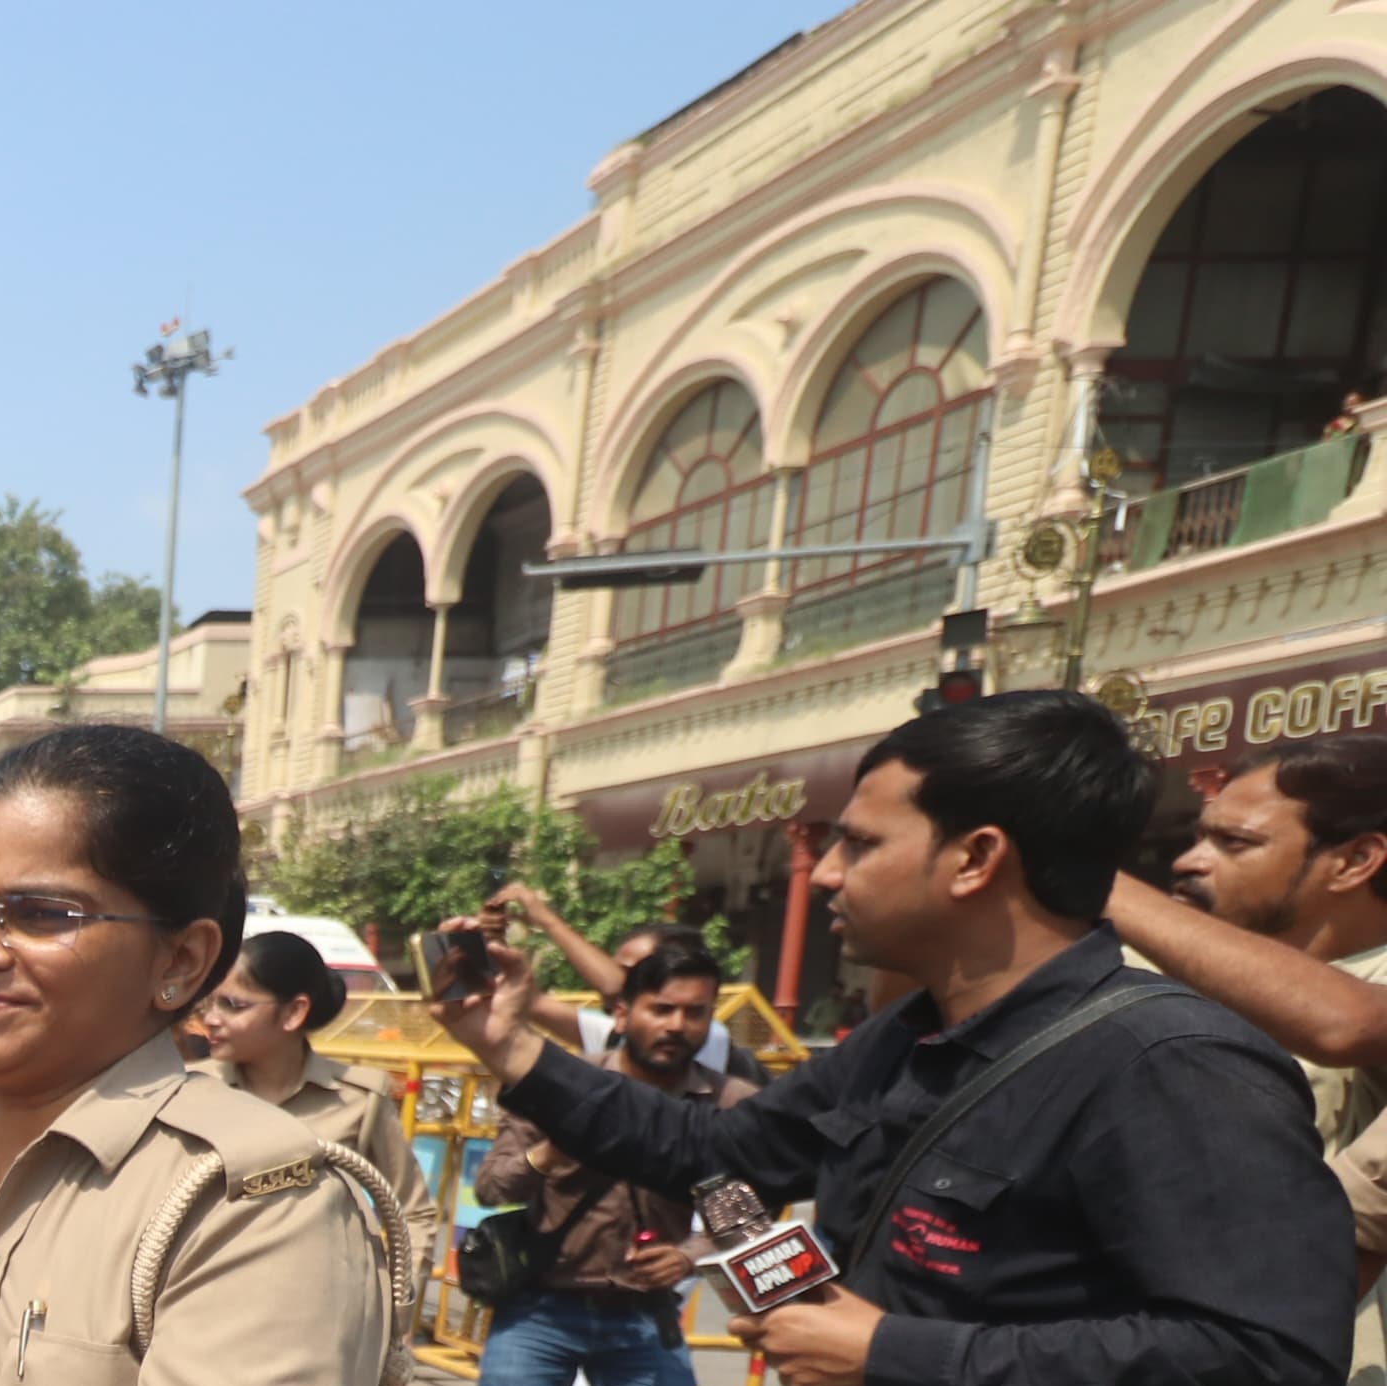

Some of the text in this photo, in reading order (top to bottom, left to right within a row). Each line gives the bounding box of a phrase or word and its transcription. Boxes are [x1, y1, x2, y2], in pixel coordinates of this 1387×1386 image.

[1245, 667, 1387, 744] COFF
[648, 770, 808, 838] Bata
[743, 1237, 806, 1277] HAMARA
[753, 1263, 796, 1295] APNA
